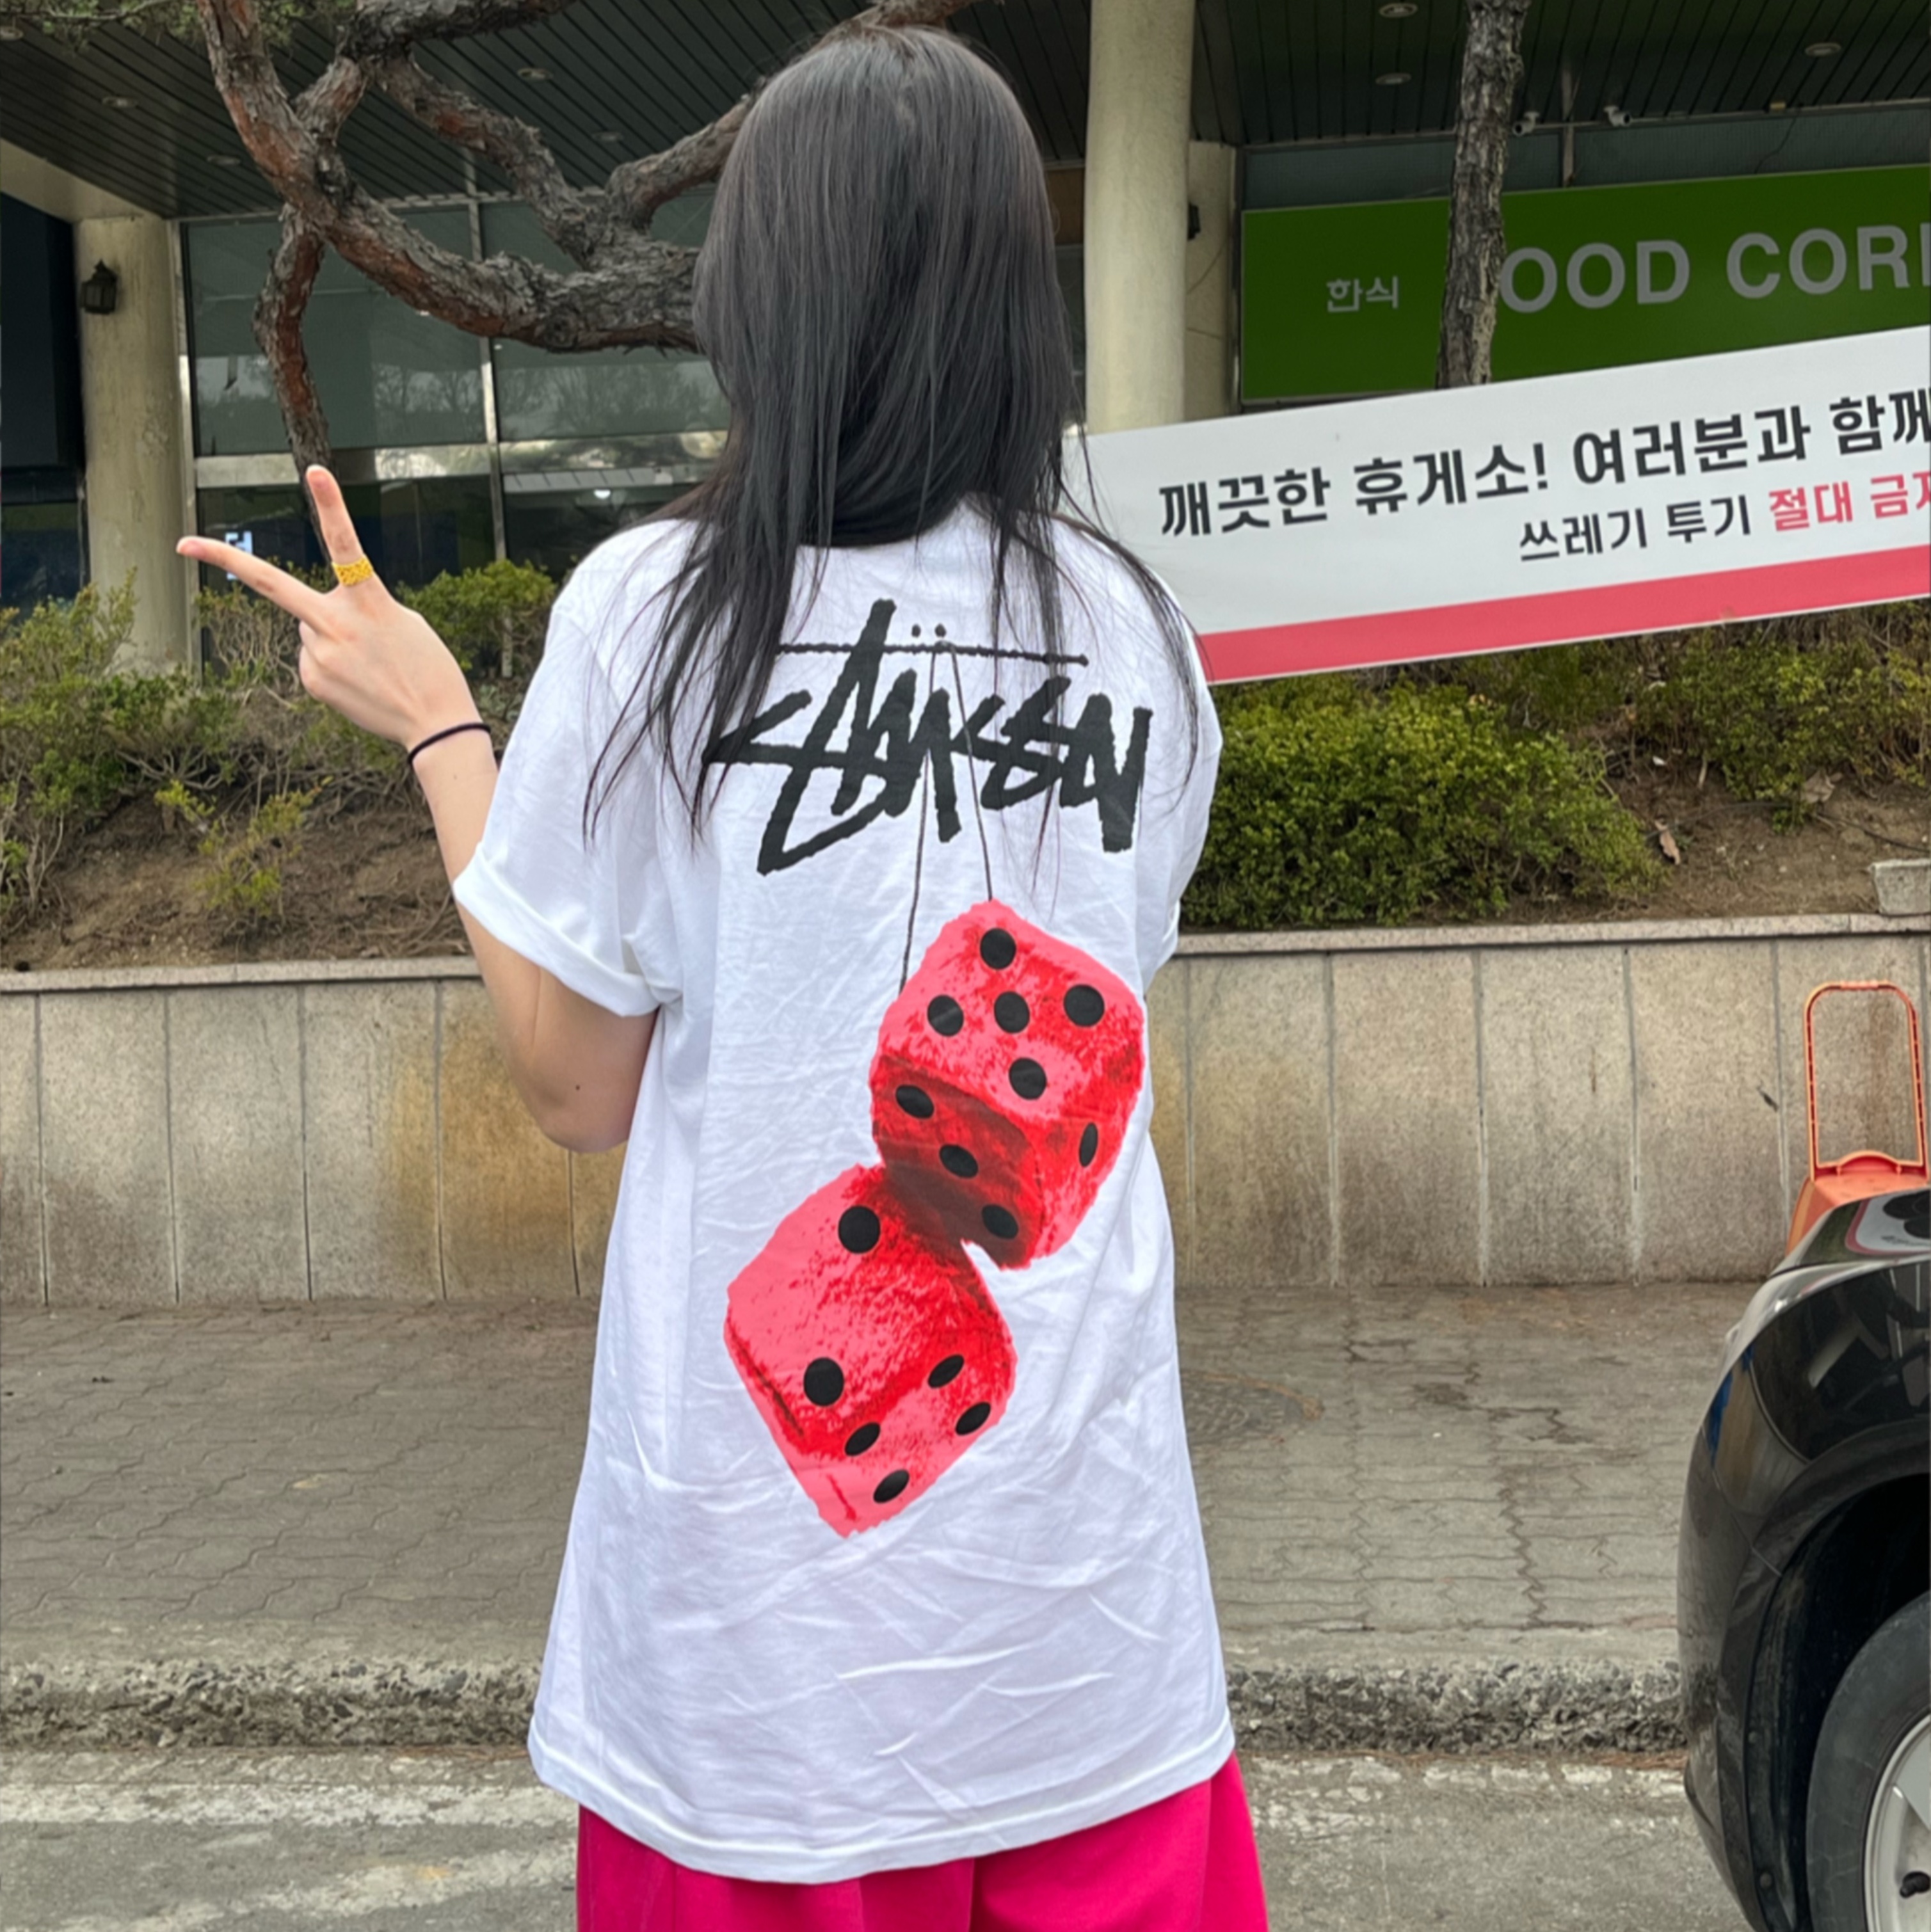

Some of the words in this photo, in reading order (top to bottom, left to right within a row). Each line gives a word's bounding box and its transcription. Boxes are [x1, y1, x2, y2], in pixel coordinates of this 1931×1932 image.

[1326, 275, 1399, 313] 한식
[1498, 239, 1690, 312] OOD
[1726, 222, 1931, 299] COR
[1159, 467, 1331, 537] 깨끗한
[1353, 443, 1546, 516] 휴게소!
[1573, 404, 1812, 484] 여러분과
[1519, 508, 1648, 563] 쓰레기
[1666, 495, 1751, 543] 투기
[1769, 481, 1854, 532] 절대
